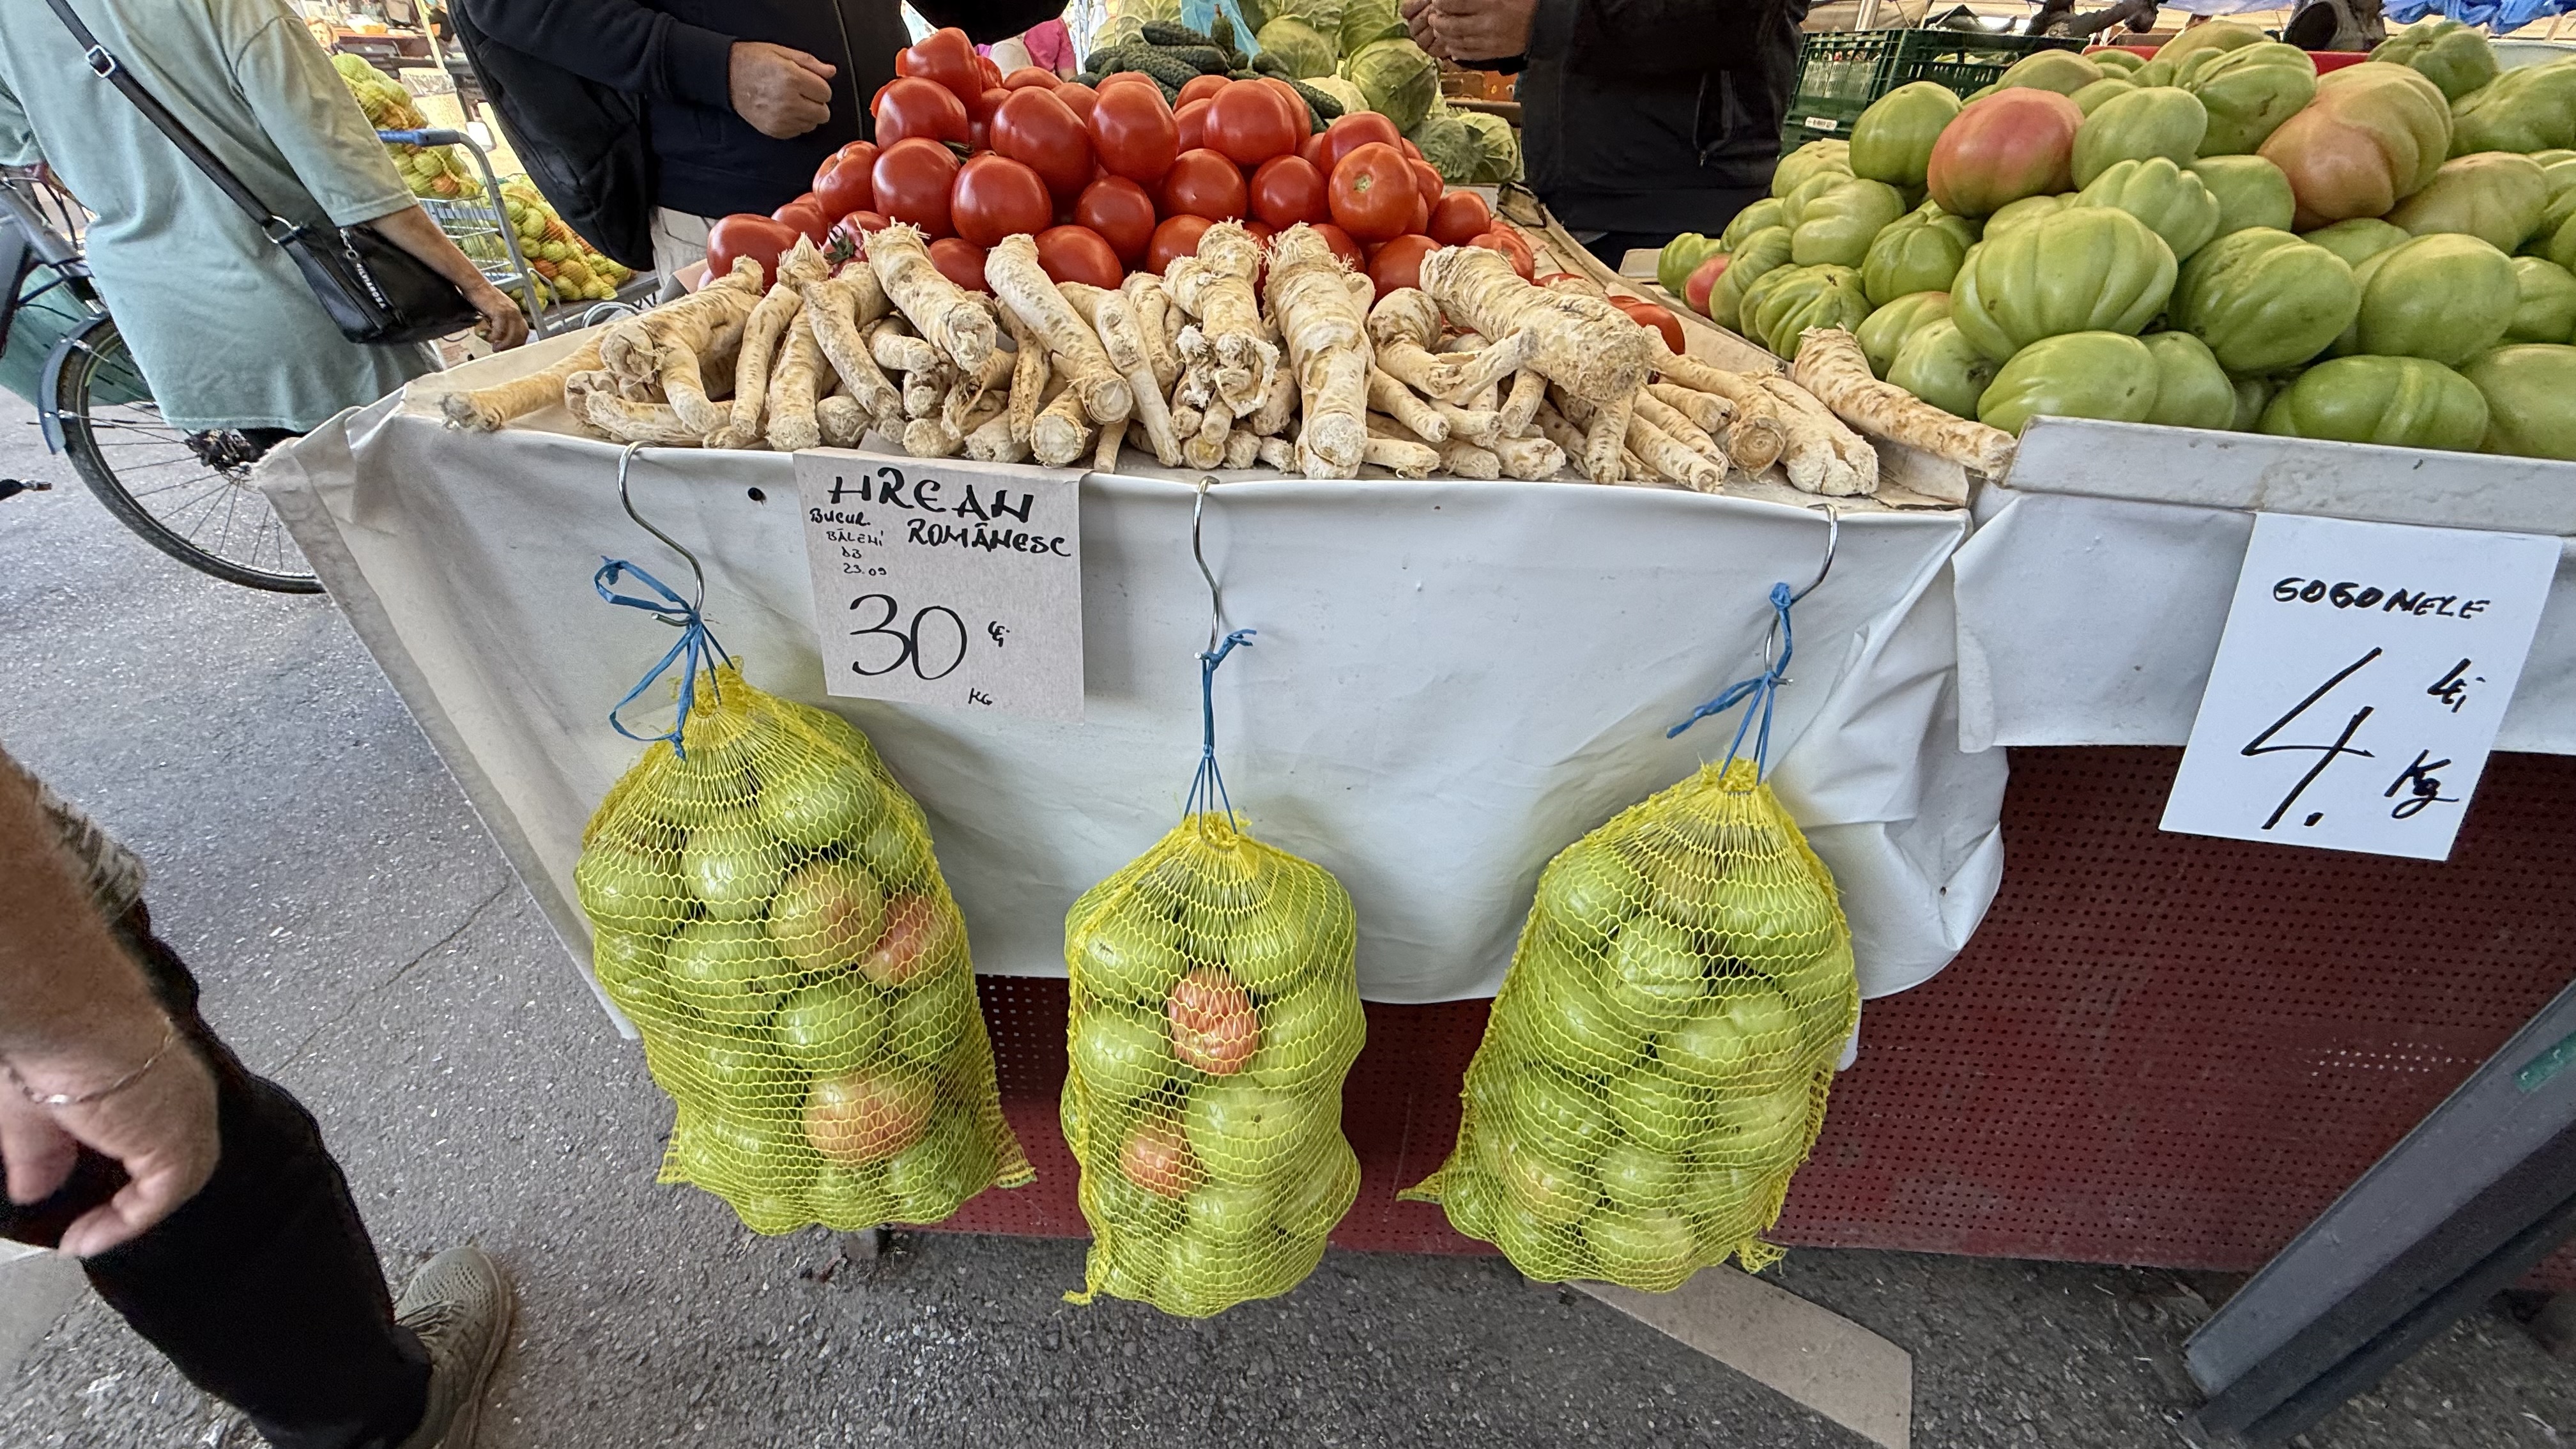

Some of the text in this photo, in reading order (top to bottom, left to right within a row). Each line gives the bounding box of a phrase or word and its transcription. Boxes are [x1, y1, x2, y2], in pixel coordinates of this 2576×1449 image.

[827, 467, 1034, 523] HREAN
[2273, 576, 2492, 619] GOGONELE
[849, 594, 968, 680] 30
